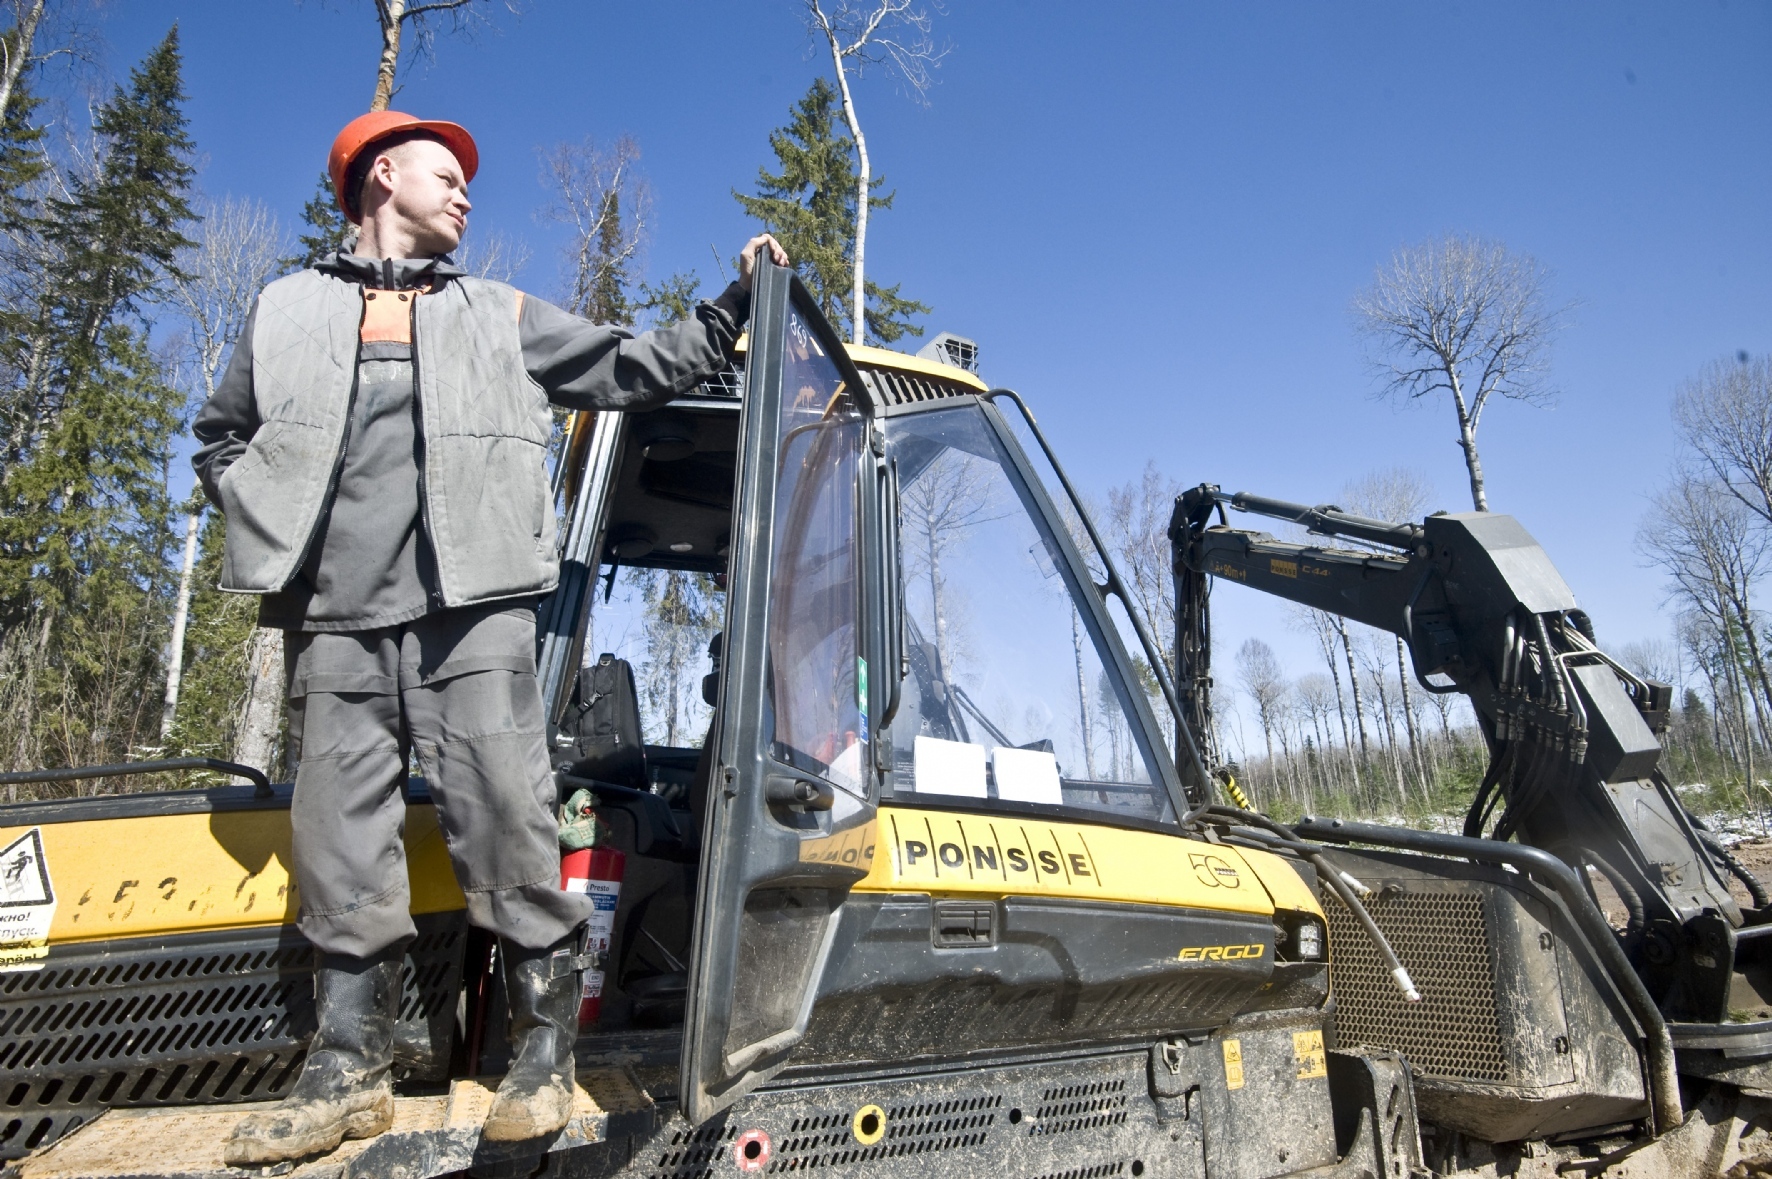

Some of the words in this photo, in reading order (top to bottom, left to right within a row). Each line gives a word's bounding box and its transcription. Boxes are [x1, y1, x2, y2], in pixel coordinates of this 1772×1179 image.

[790, 313, 807, 348] 869
[905, 840, 1091, 877] PONSSE
[590, 883, 610, 892] Presto
[0, 927, 38, 939] пуск.
[1178, 944, 1265, 961] ERGO
